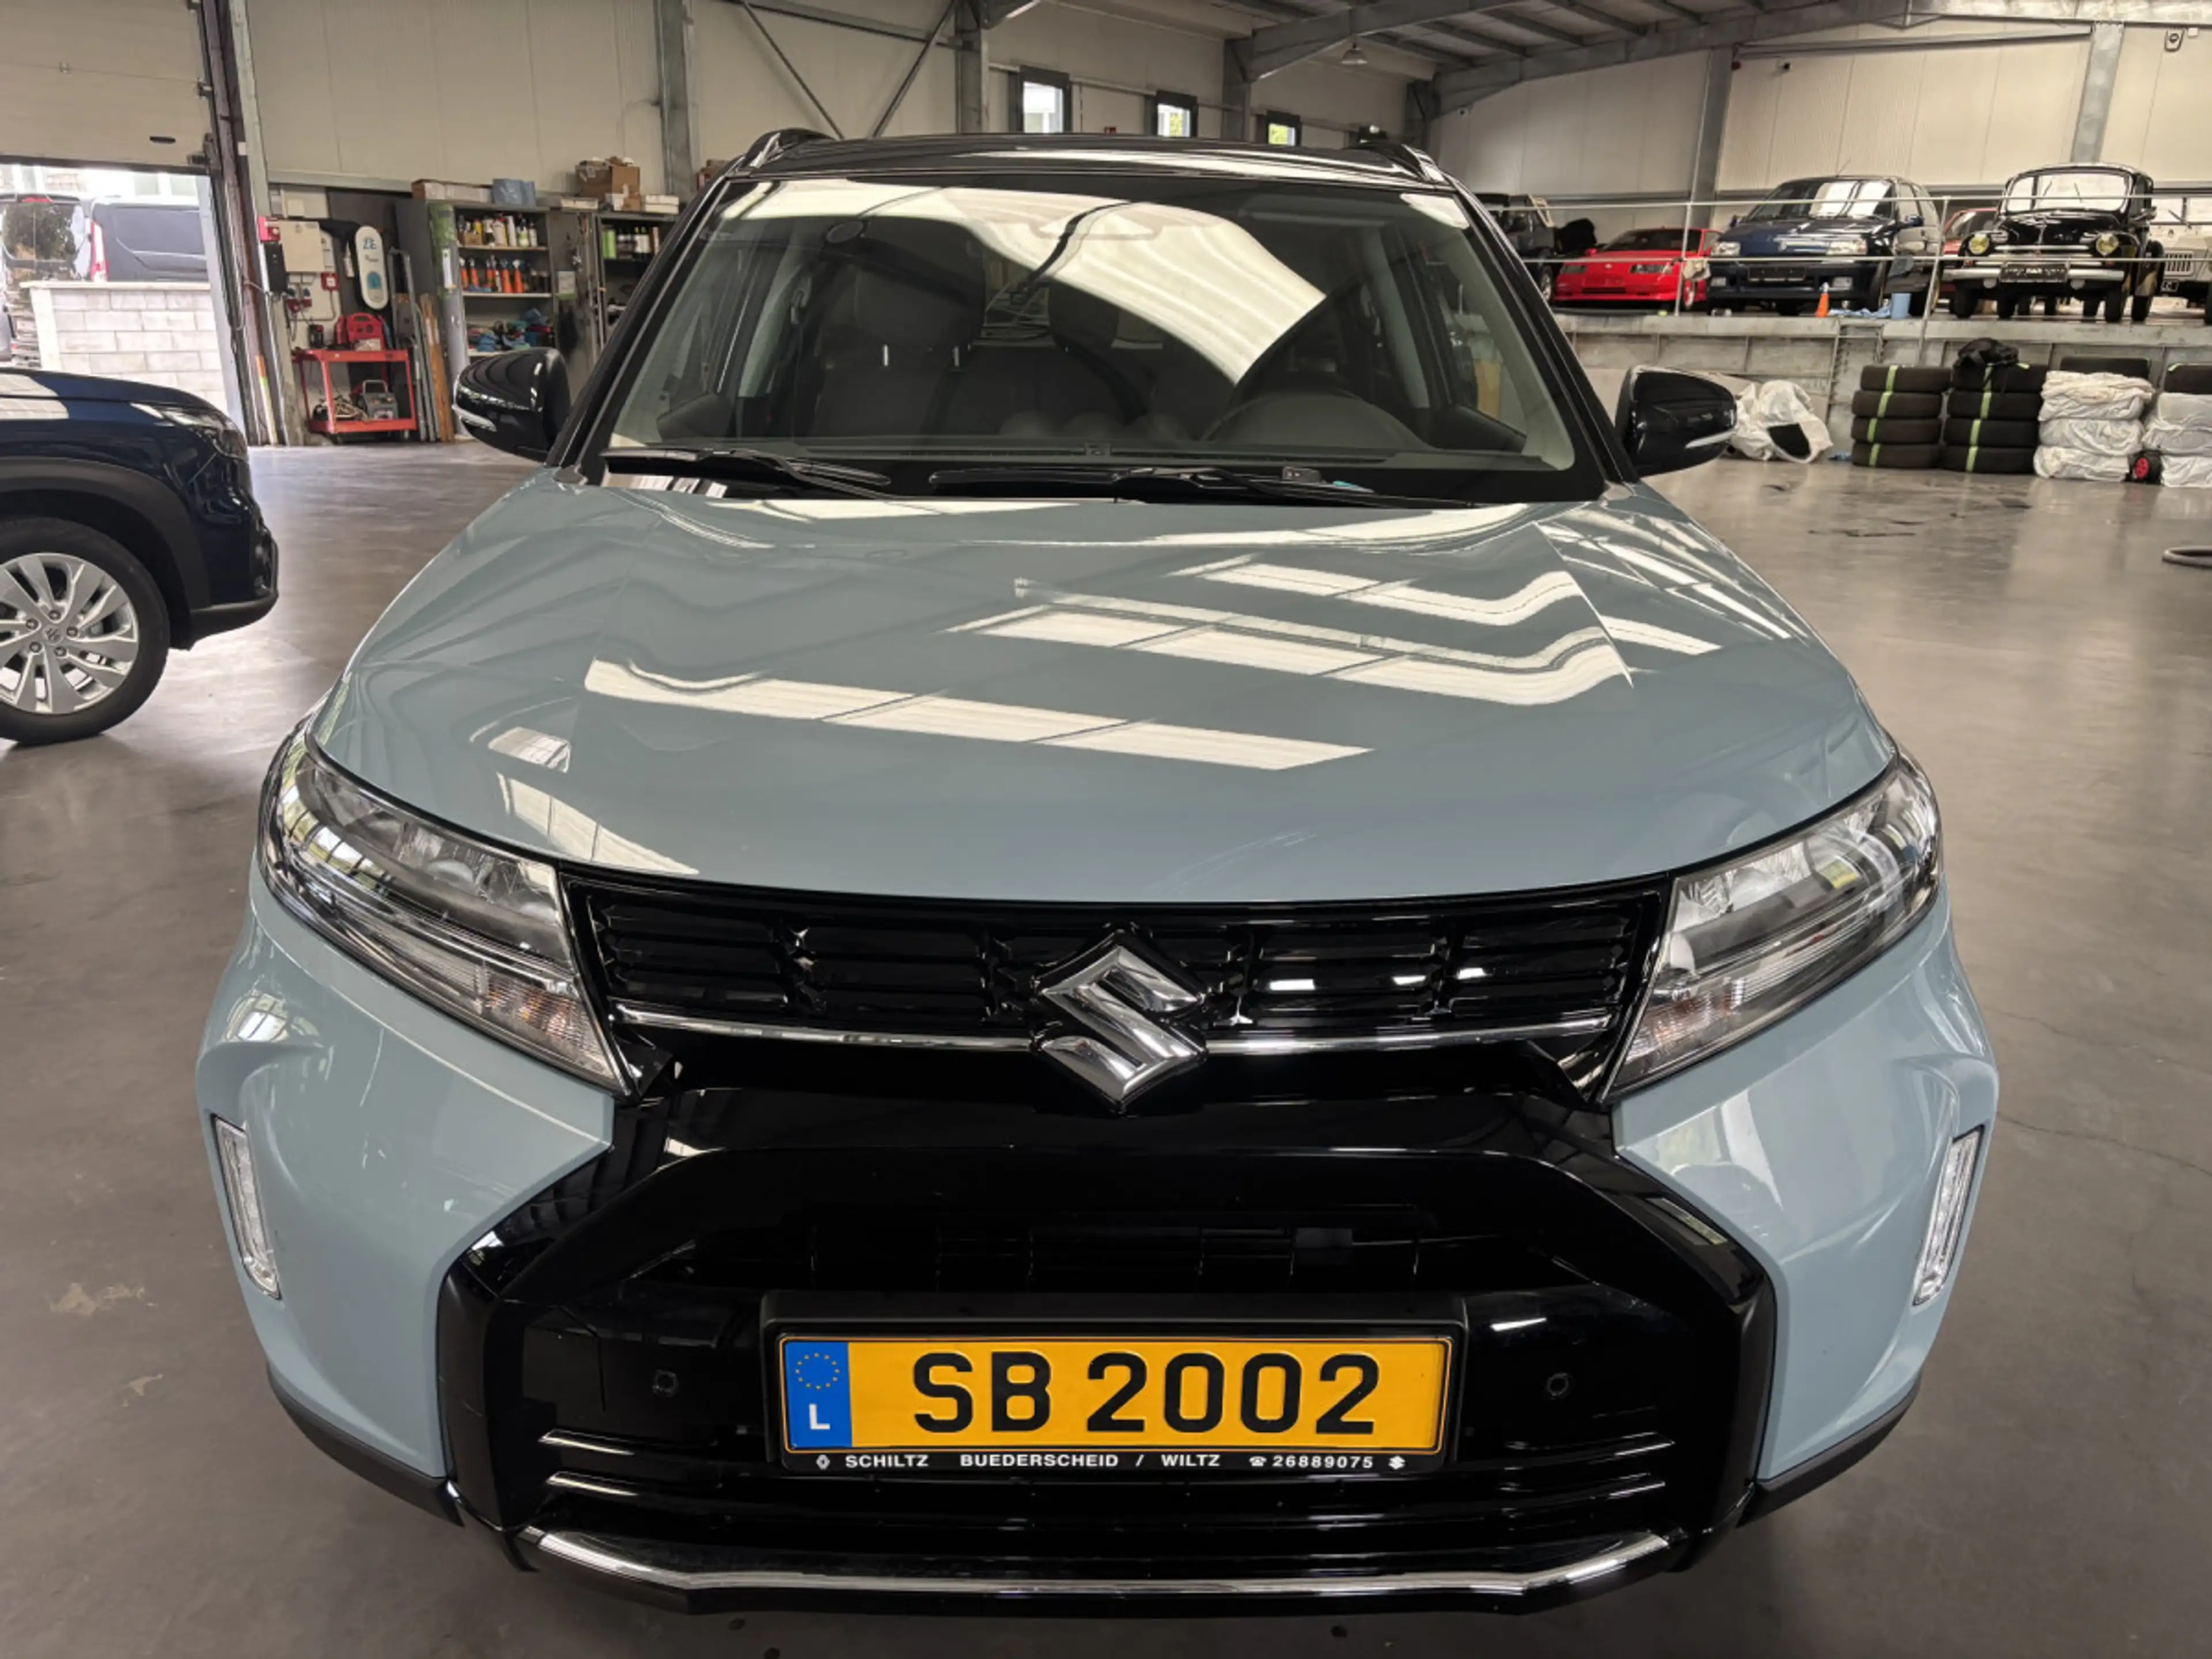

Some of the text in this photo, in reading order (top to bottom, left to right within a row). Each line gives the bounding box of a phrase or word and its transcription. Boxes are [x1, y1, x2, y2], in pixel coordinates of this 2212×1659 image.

[914, 1352, 1378, 1434] SB 2002
[809, 1404, 831, 1430] L
[845, 1455, 929, 1469] SCHILTZ
[960, 1454, 1119, 1467] BUEDERSCHEID
[1161, 1454, 1221, 1467] WILTZ
[1272, 1455, 1373, 1468] 26889075
